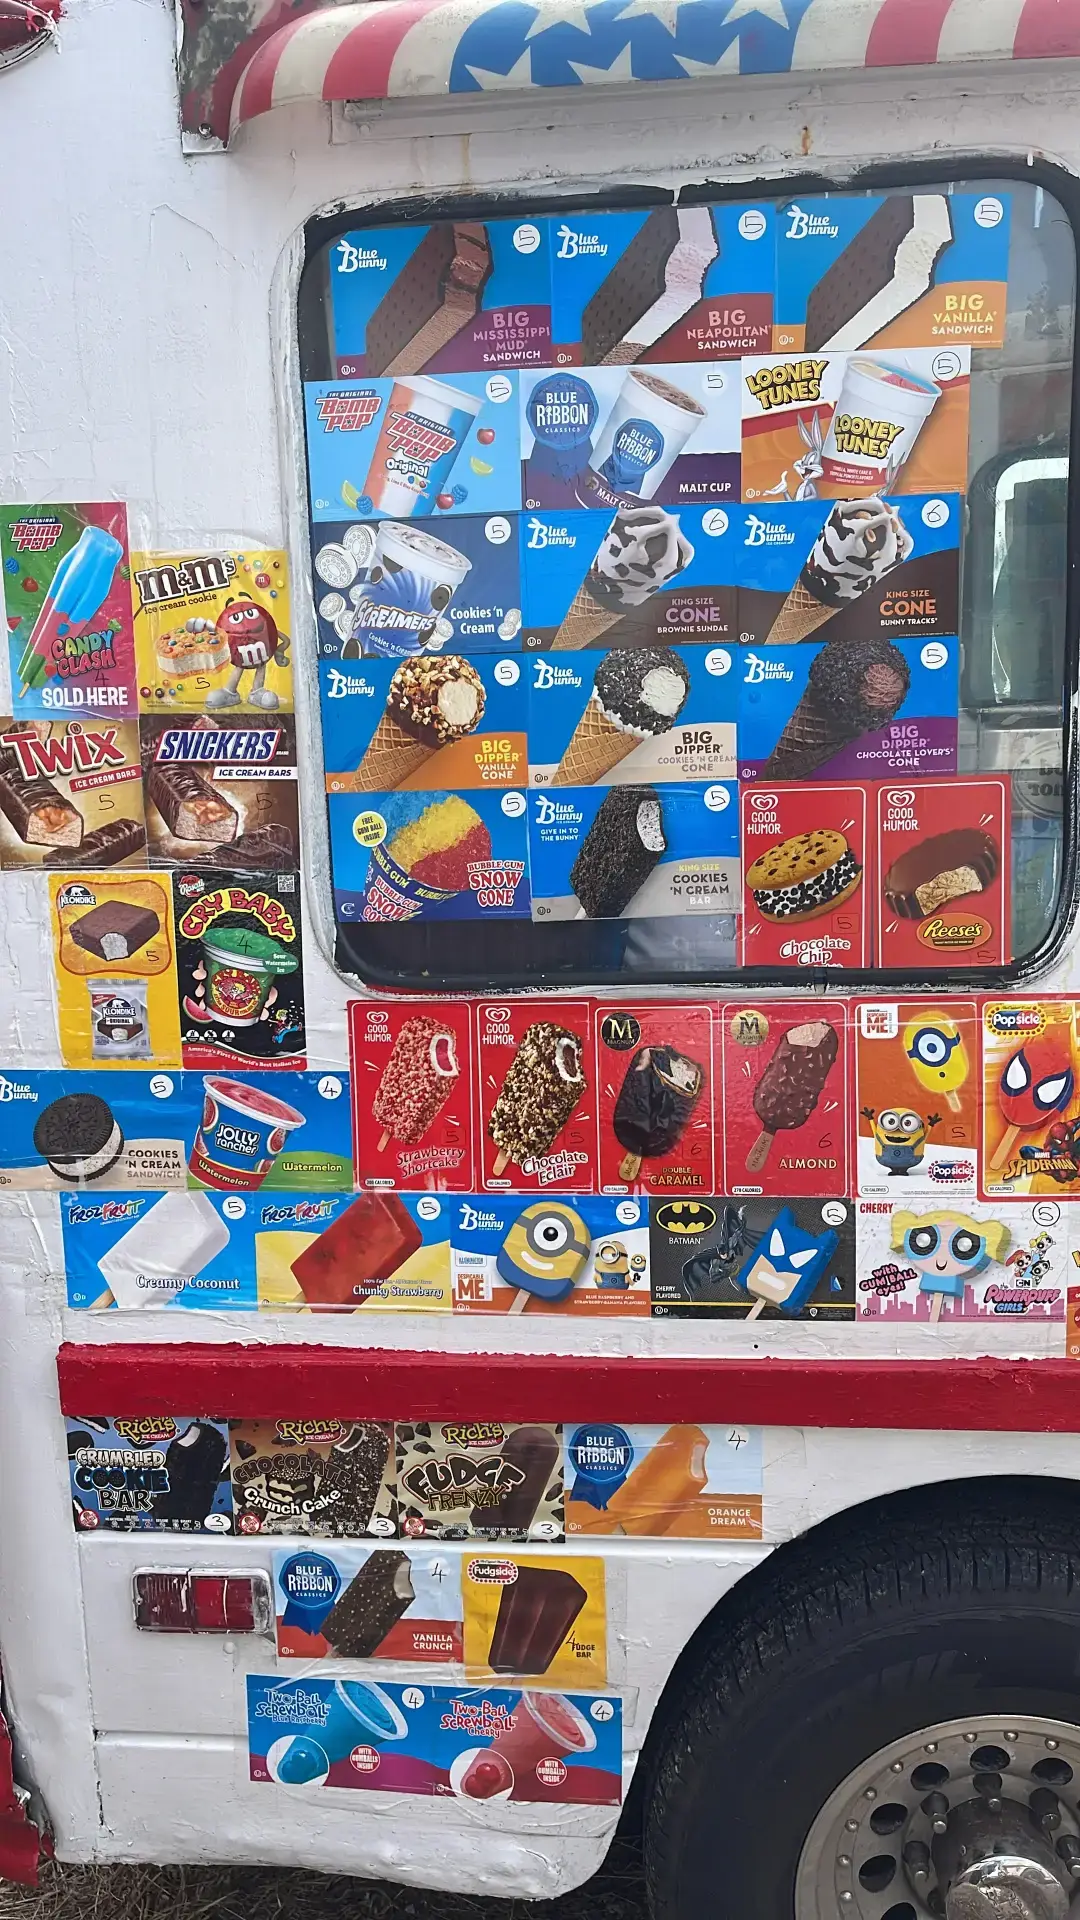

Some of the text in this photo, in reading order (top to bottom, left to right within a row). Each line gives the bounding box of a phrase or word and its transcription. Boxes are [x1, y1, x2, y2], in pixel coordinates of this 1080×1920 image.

[945, 294, 984, 310] BIG
[493, 312, 529, 328] BIG
[709, 310, 746, 326] BIG
[933, 312, 995, 323] VANILLA
[473, 324, 550, 341] MISSISSIPPI
[687, 325, 769, 340] NEAPOLITAN
[932, 325, 993, 335] SANDWICH
[698, 339, 757, 349] SANDWICH
[483, 350, 540, 362] SANDWICH
[745, 359, 829, 394] LOONEY
[546, 392, 577, 404] BLUE
[756, 381, 821, 409] TUNES
[536, 404, 589, 427] RIBBON
[834, 414, 904, 441] LOONEY
[630, 429, 653, 446] BLUE
[617, 434, 656, 465] RIBBON
[835, 433, 892, 459] TUNES
[386, 458, 429, 476] Original
[679, 483, 731, 493] MALT CUP
[886, 590, 908, 598] KING
[145, 593, 217, 614] ice cream cookie
[672, 598, 693, 606] KING
[879, 599, 937, 616] CONE
[352, 599, 438, 631] SCREAMERS
[450, 608, 491, 620] Cookies
[666, 607, 720, 623] CONE
[460, 622, 495, 634] Cream
[51, 630, 114, 659] CANDY
[57, 649, 116, 679] CLASH
[42, 687, 87, 707] SOLD
[88, 686, 128, 705] HERE
[682, 731, 712, 744] BIG
[890, 726, 918, 739] BIG
[160, 732, 276, 759] SNICKERS
[482, 740, 511, 753] BIG
[675, 744, 720, 754] DIPPER
[882, 739, 927, 749] DIPPER
[475, 752, 519, 764] DIPPER
[658, 756, 694, 764] COOKIES
[857, 750, 911, 759] CHOCOLATE
[478, 763, 516, 771] VANILLA
[682, 764, 713, 772] CONE
[888, 758, 919, 767] CONE
[75, 770, 136, 788] ICE CREAM BARS
[482, 770, 513, 779] CONE
[99, 795, 114, 810] 5
[256, 793, 272, 810] 5
[751, 812, 777, 823] GOOD
[747, 824, 781, 835] HUMOR
[468, 862, 525, 871] BUBBLE GUM
[469, 871, 522, 890] SNOW
[673, 873, 728, 883] COOKIES
[686, 885, 729, 894] CREAM
[60, 896, 96, 908] KLONDIKE
[477, 890, 515, 907] CONE
[690, 897, 710, 905] BAR
[181, 890, 295, 937] CRY BABY
[924, 920, 982, 938] Reese's
[780, 936, 850, 958] Chocolate
[146, 951, 159, 961] 5
[798, 951, 831, 965] Chip
[103, 1007, 135, 1017] KLONDIKE
[992, 1014, 1041, 1027] Popsicle
[367, 1024, 388, 1033] GOOD
[486, 1024, 510, 1033] GOOD
[364, 1033, 392, 1042] HUMOR
[482, 1035, 514, 1044] HUMOR
[217, 1125, 260, 1146] JOLLY
[819, 1133, 832, 1148] 6
[216, 1138, 257, 1155] rancher
[128, 1150, 178, 1158] COOKIES
[397, 1147, 464, 1166] Strawberry
[283, 1163, 342, 1171] Watermelon
[401, 1159, 458, 1178] Shortcake
[522, 1151, 587, 1175] Chocolate
[779, 1159, 837, 1169] ALMOND
[199, 1160, 249, 1186] Watermelon
[539, 1166, 575, 1185] Eclair
[650, 1175, 704, 1185] CARAMEL
[860, 1203, 893, 1213] CHERRY
[669, 1237, 700, 1245] BATMAN
[136, 1274, 239, 1292] Creamy Coconut
[458, 1280, 484, 1299] ME
[353, 1285, 443, 1299] Chunky Strawberry
[996, 1303, 1023, 1313] GIRLS
[586, 1437, 614, 1446] BLUE
[728, 1431, 746, 1450] 4
[76, 1449, 165, 1468] CRUMBLED
[578, 1446, 624, 1465] RIBBON
[233, 1454, 351, 1488] CHOCOLATE
[75, 1467, 170, 1491] COOKIE
[402, 1454, 526, 1504] FUDGE
[99, 1489, 154, 1511] BAR
[243, 1486, 342, 1515] Crunch Cake
[708, 1509, 750, 1517] ORANGE
[711, 1517, 746, 1525] DREAM
[296, 1566, 322, 1575] BLUE
[288, 1575, 332, 1592] RIBBON
[413, 1642, 452, 1650] CRUNCH
[352, 1755, 379, 1763] GUMBALLS
